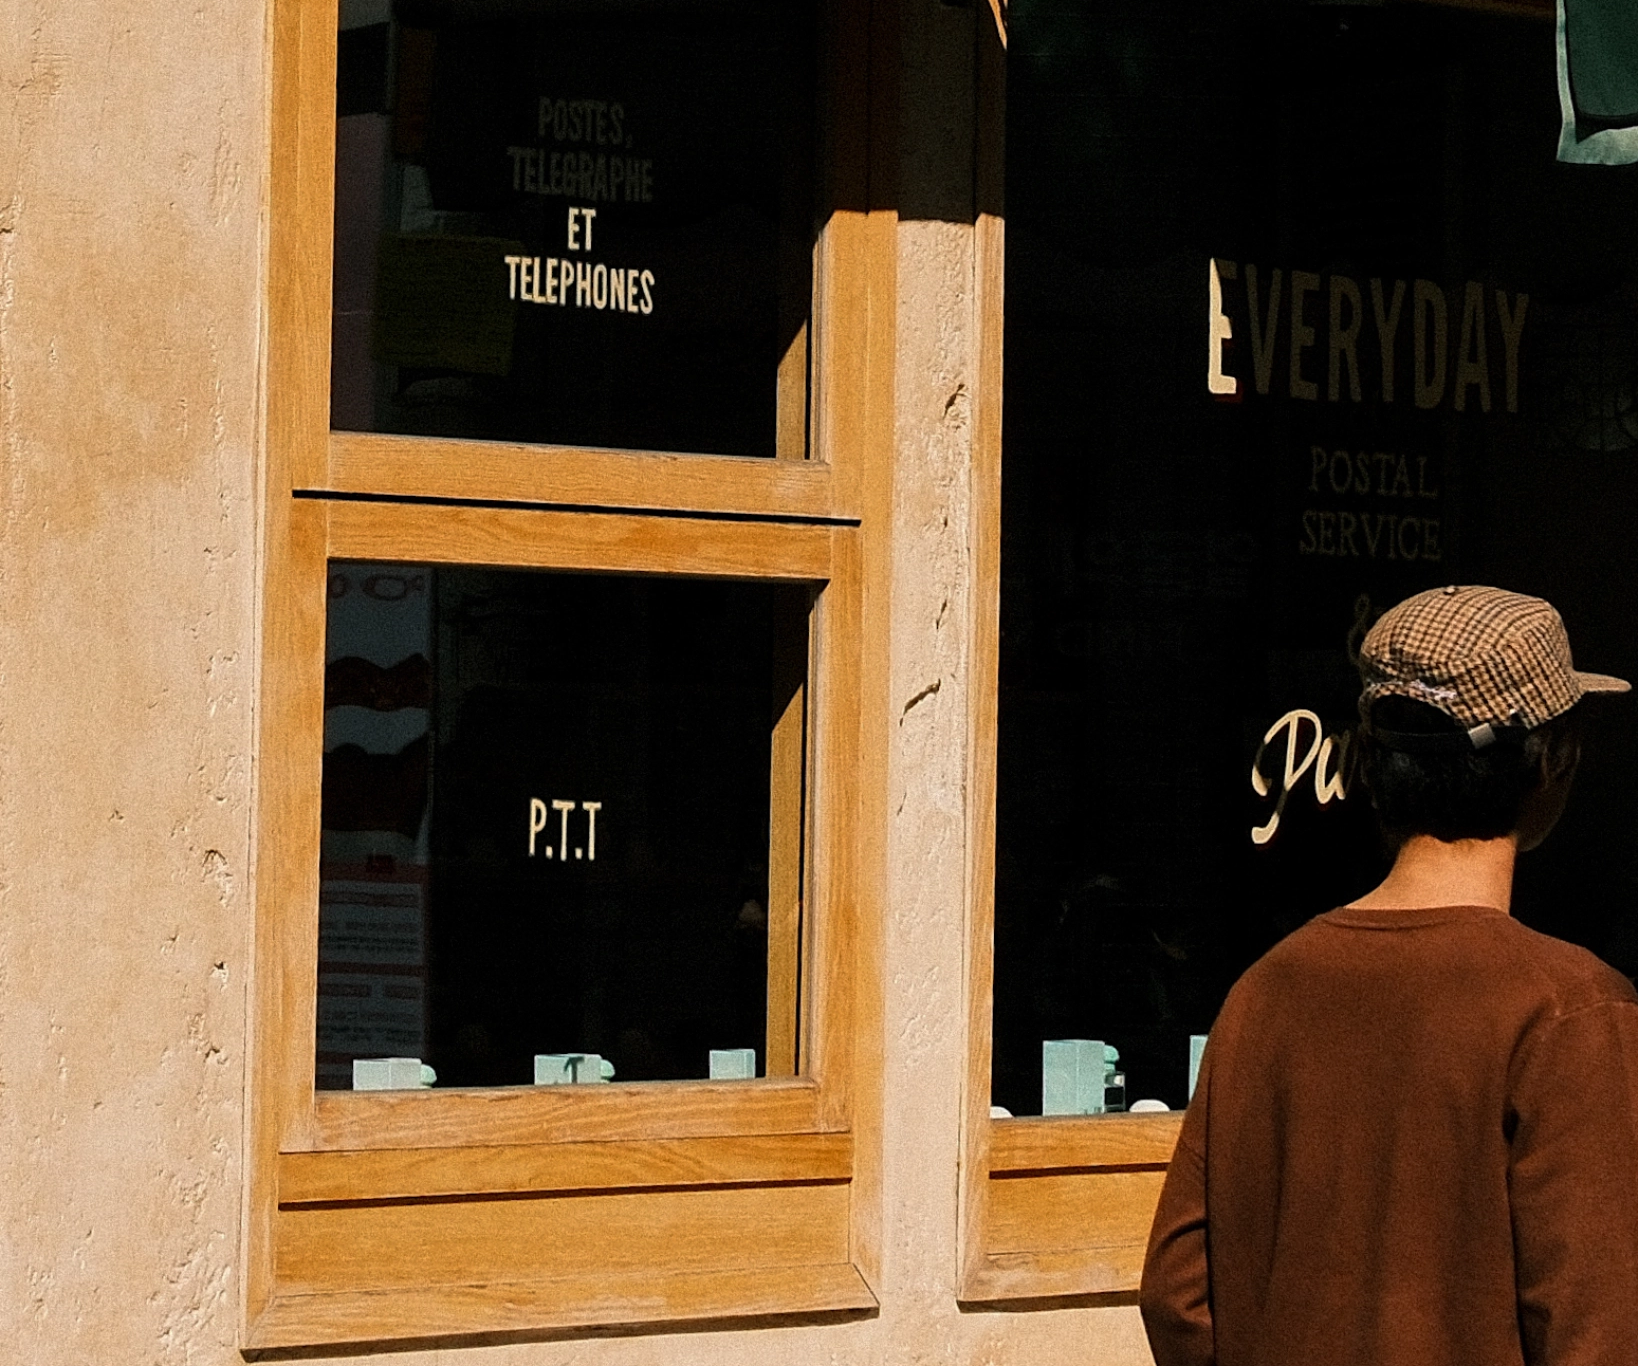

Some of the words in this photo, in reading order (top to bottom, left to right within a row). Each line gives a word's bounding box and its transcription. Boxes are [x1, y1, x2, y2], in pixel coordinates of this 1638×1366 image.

[537, 95, 633, 149] POSTES,
[506, 145, 654, 203] TELEGRAPHE
[567, 206, 597, 253] ET
[504, 254, 656, 316] TELEPHONES
[1208, 257, 1530, 413] EVERYDAY
[1309, 445, 1440, 499] POSTAL
[1299, 508, 1442, 562] SERVICE
[527, 796, 603, 862] P.T.T
